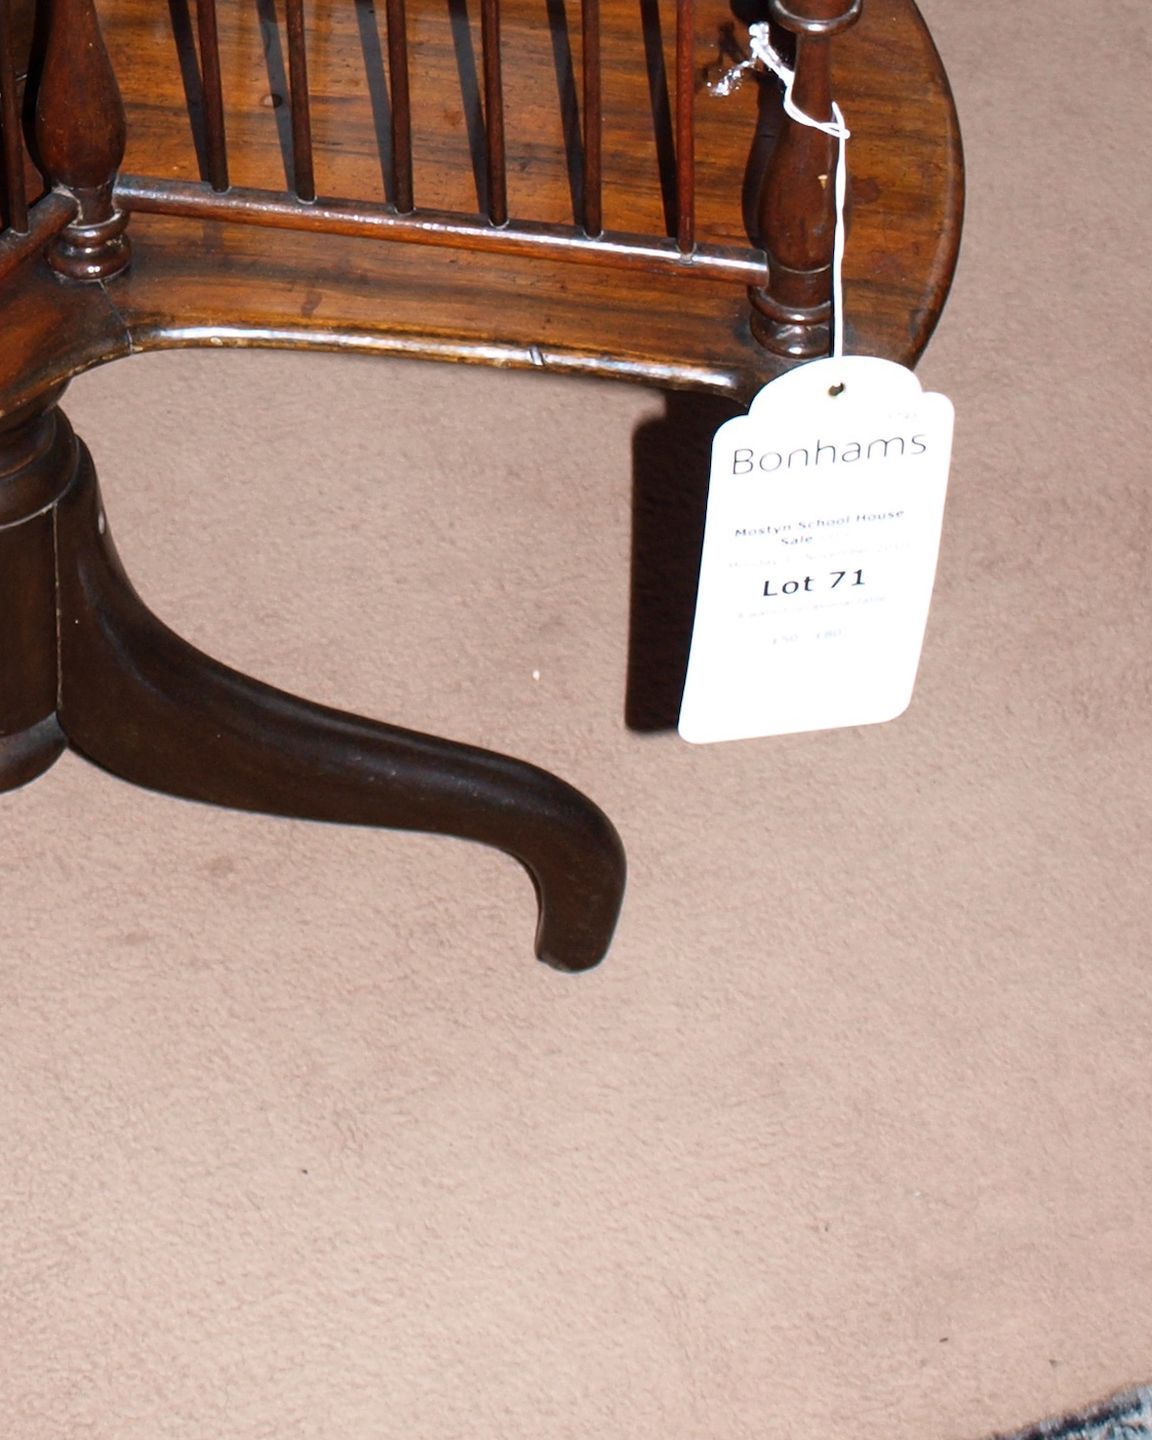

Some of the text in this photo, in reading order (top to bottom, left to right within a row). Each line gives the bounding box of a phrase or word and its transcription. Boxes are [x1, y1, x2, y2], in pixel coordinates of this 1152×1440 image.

[732, 433, 927, 475] Bonhams
[735, 509, 905, 538] Mostyn School House
[780, 534, 814, 546] Sale
[762, 569, 866, 597] Lot 71
